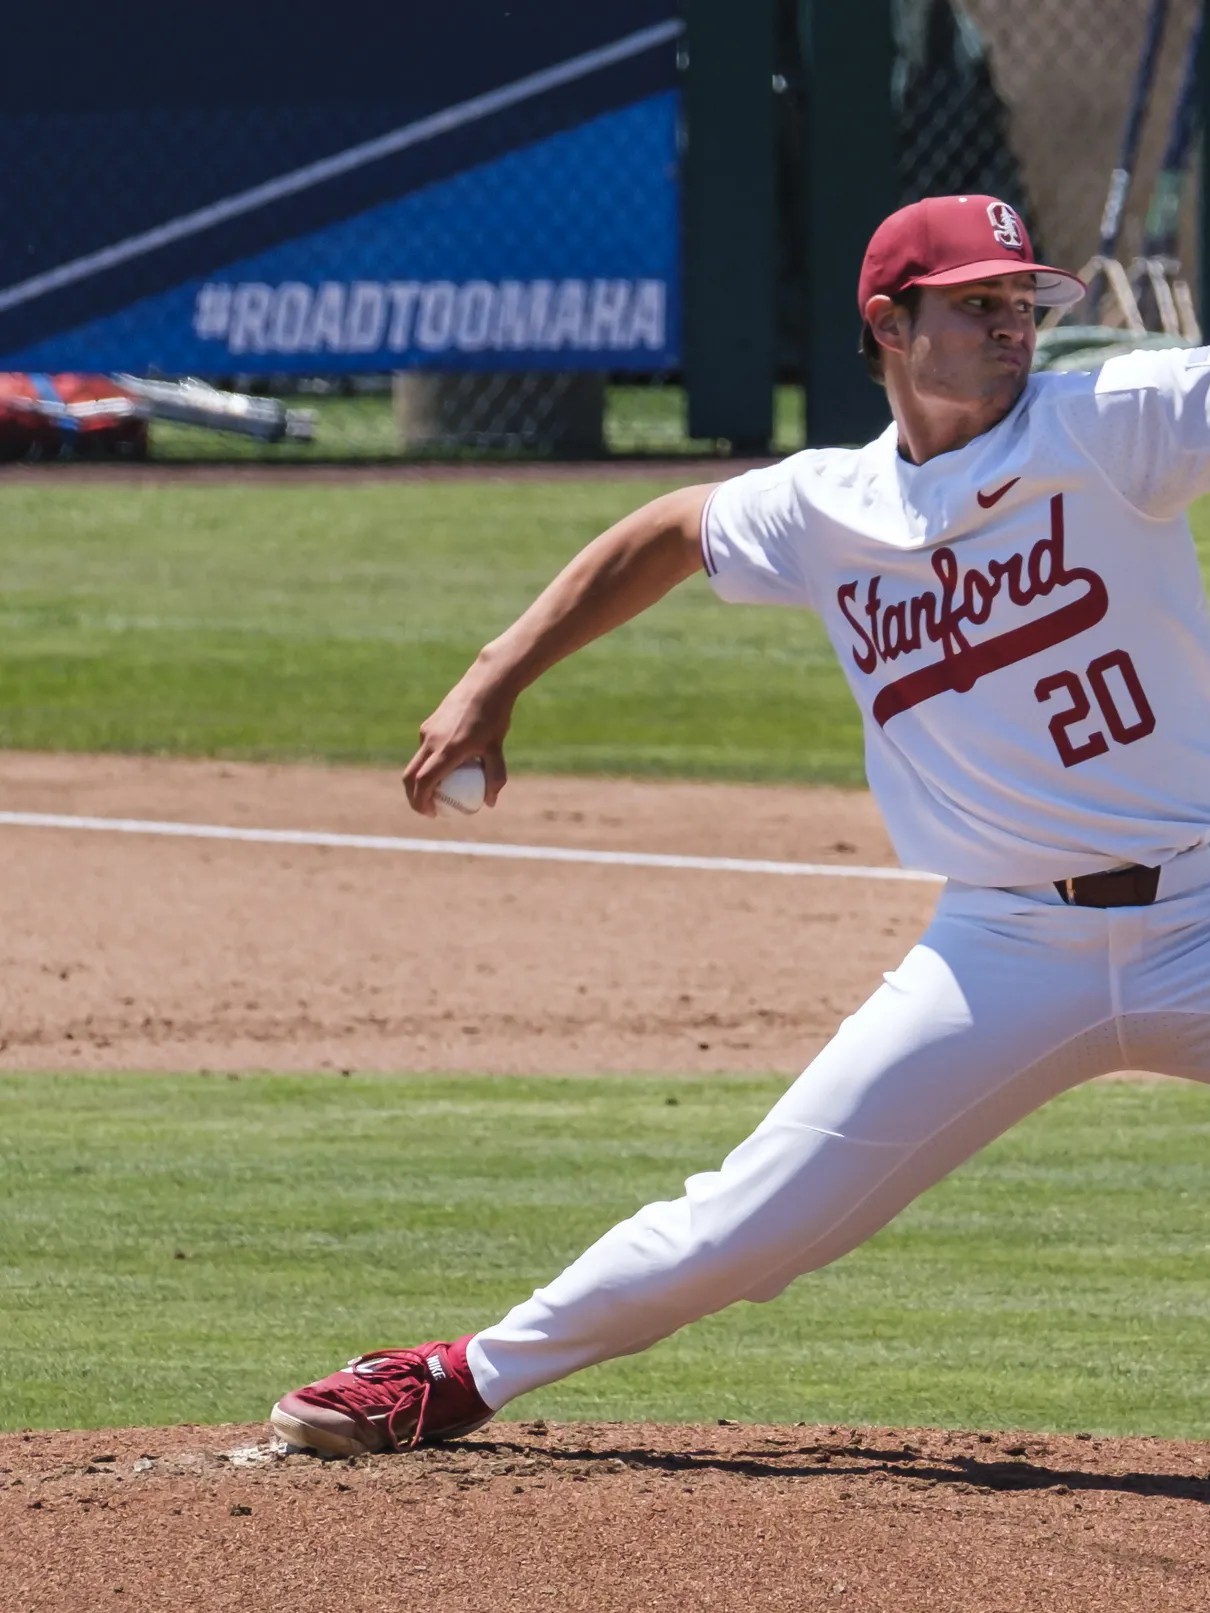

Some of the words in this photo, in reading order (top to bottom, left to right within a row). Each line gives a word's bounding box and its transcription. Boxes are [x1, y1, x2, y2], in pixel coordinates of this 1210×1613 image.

[194, 279, 666, 354] #ROADTOOMAHA
[837, 492, 1066, 690] Stanford
[1034, 649, 1157, 768] 20
[426, 1354, 447, 1381] NIKE
